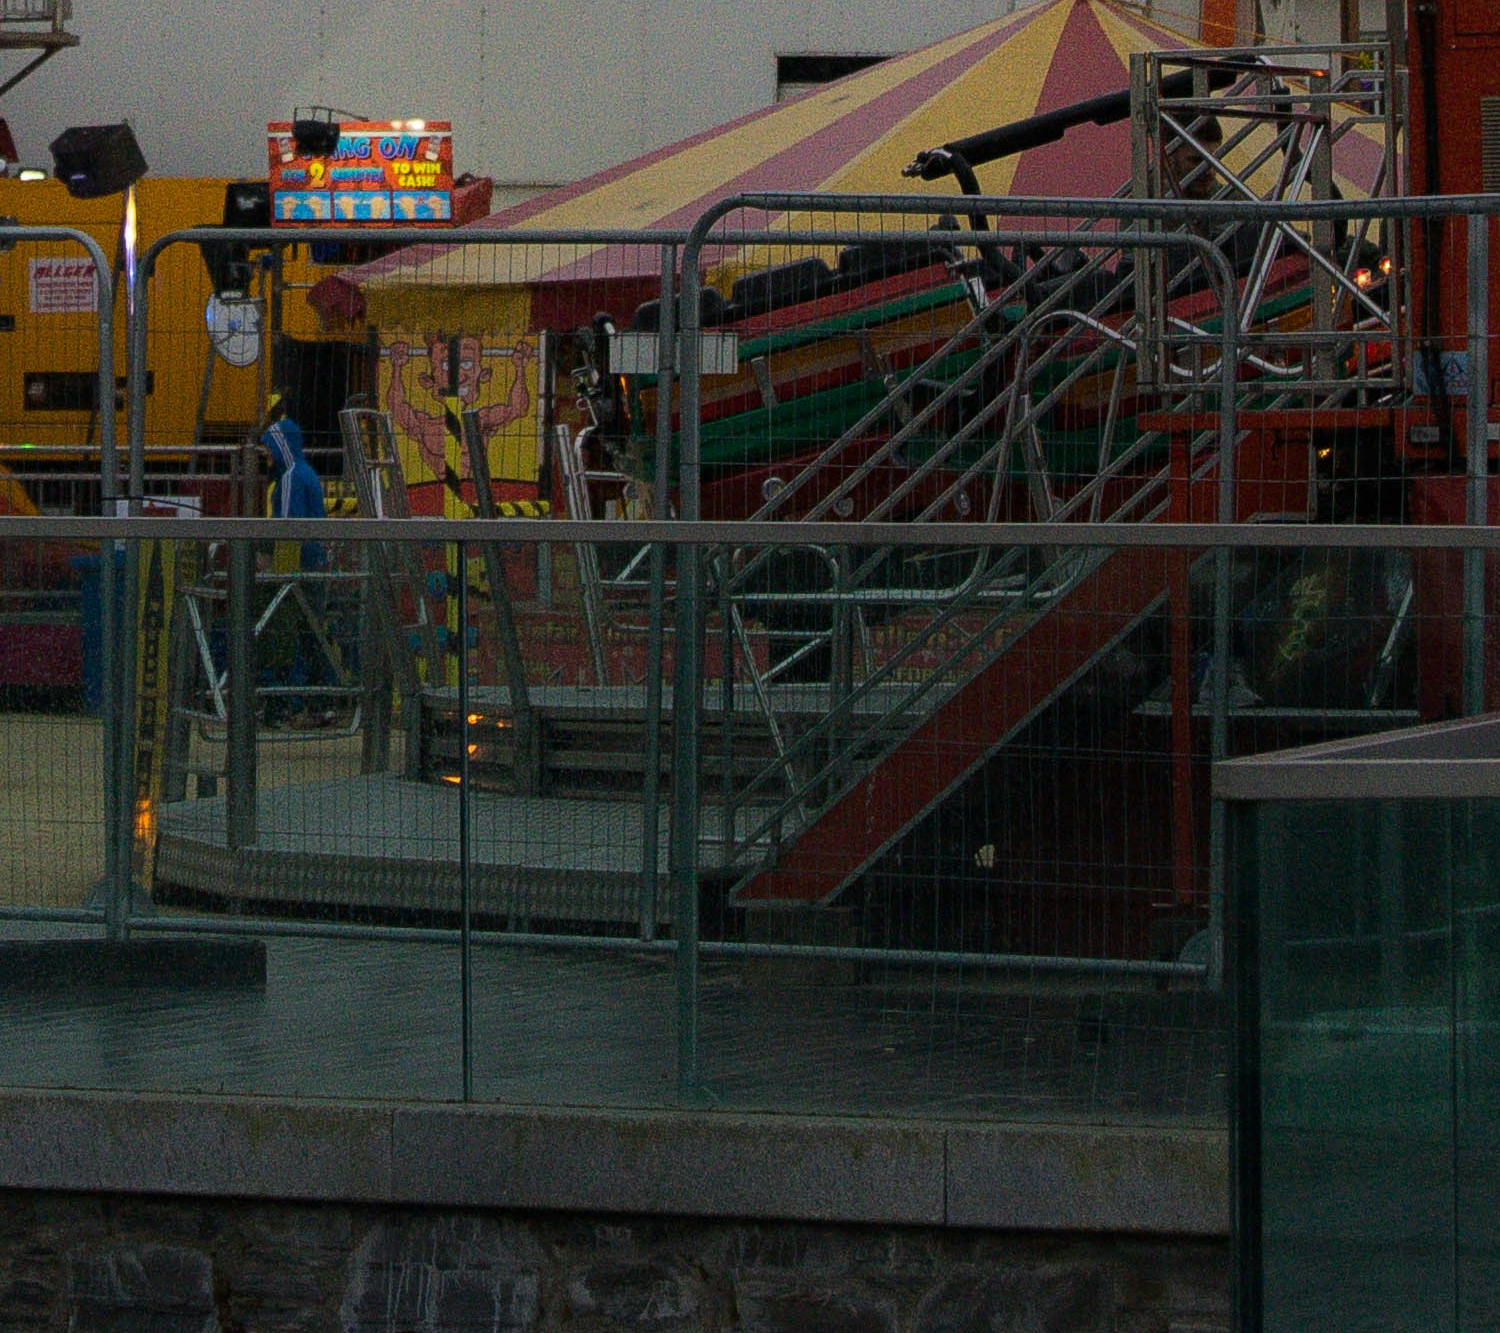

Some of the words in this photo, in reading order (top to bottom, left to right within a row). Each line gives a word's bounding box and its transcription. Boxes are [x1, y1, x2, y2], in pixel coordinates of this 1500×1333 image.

[378, 133, 420, 159] ON
[309, 162, 326, 188] 2
[391, 162, 410, 174] TO
[413, 161, 442, 174] WIN
